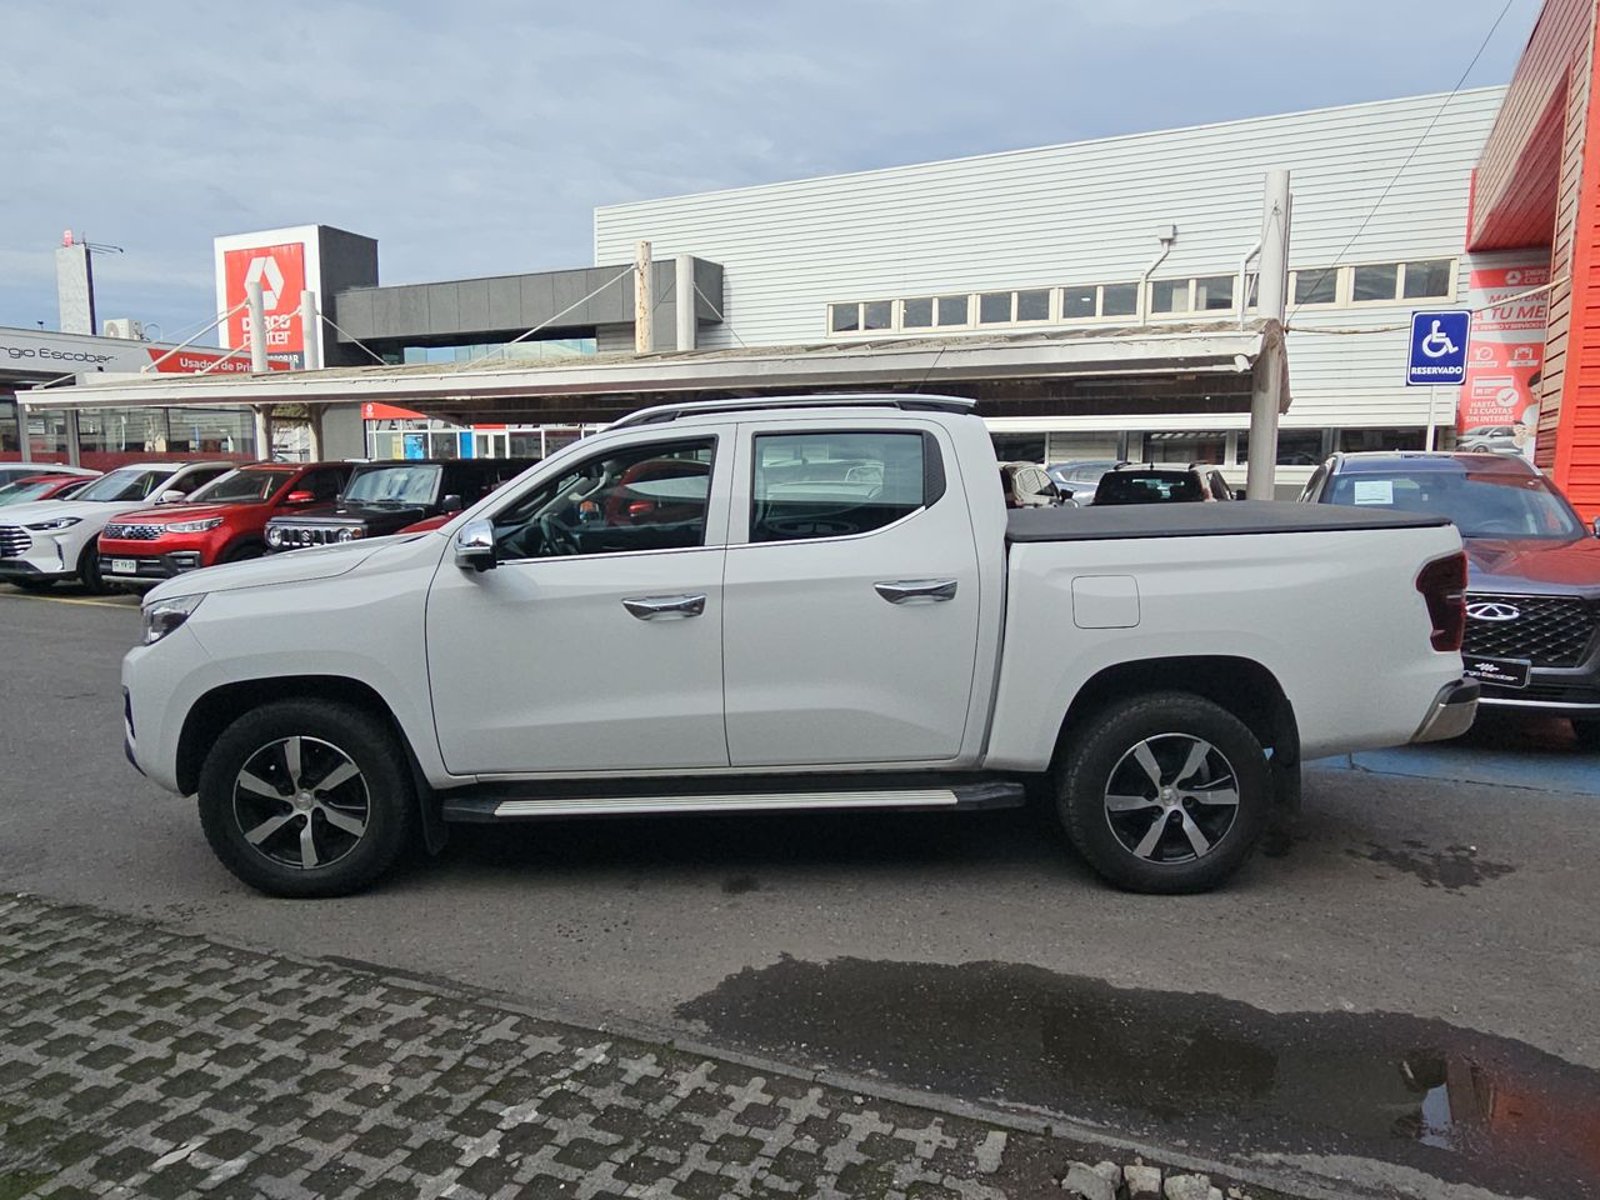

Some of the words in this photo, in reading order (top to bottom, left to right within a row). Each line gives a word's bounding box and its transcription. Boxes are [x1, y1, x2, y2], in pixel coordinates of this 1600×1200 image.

[1491, 305, 1513, 320] TU
[1517, 304, 1547, 319] ME
[242, 314, 290, 331] DRCO
[1411, 366, 1462, 375] RESERVADO
[1480, 406, 1513, 415] CUOTAS
